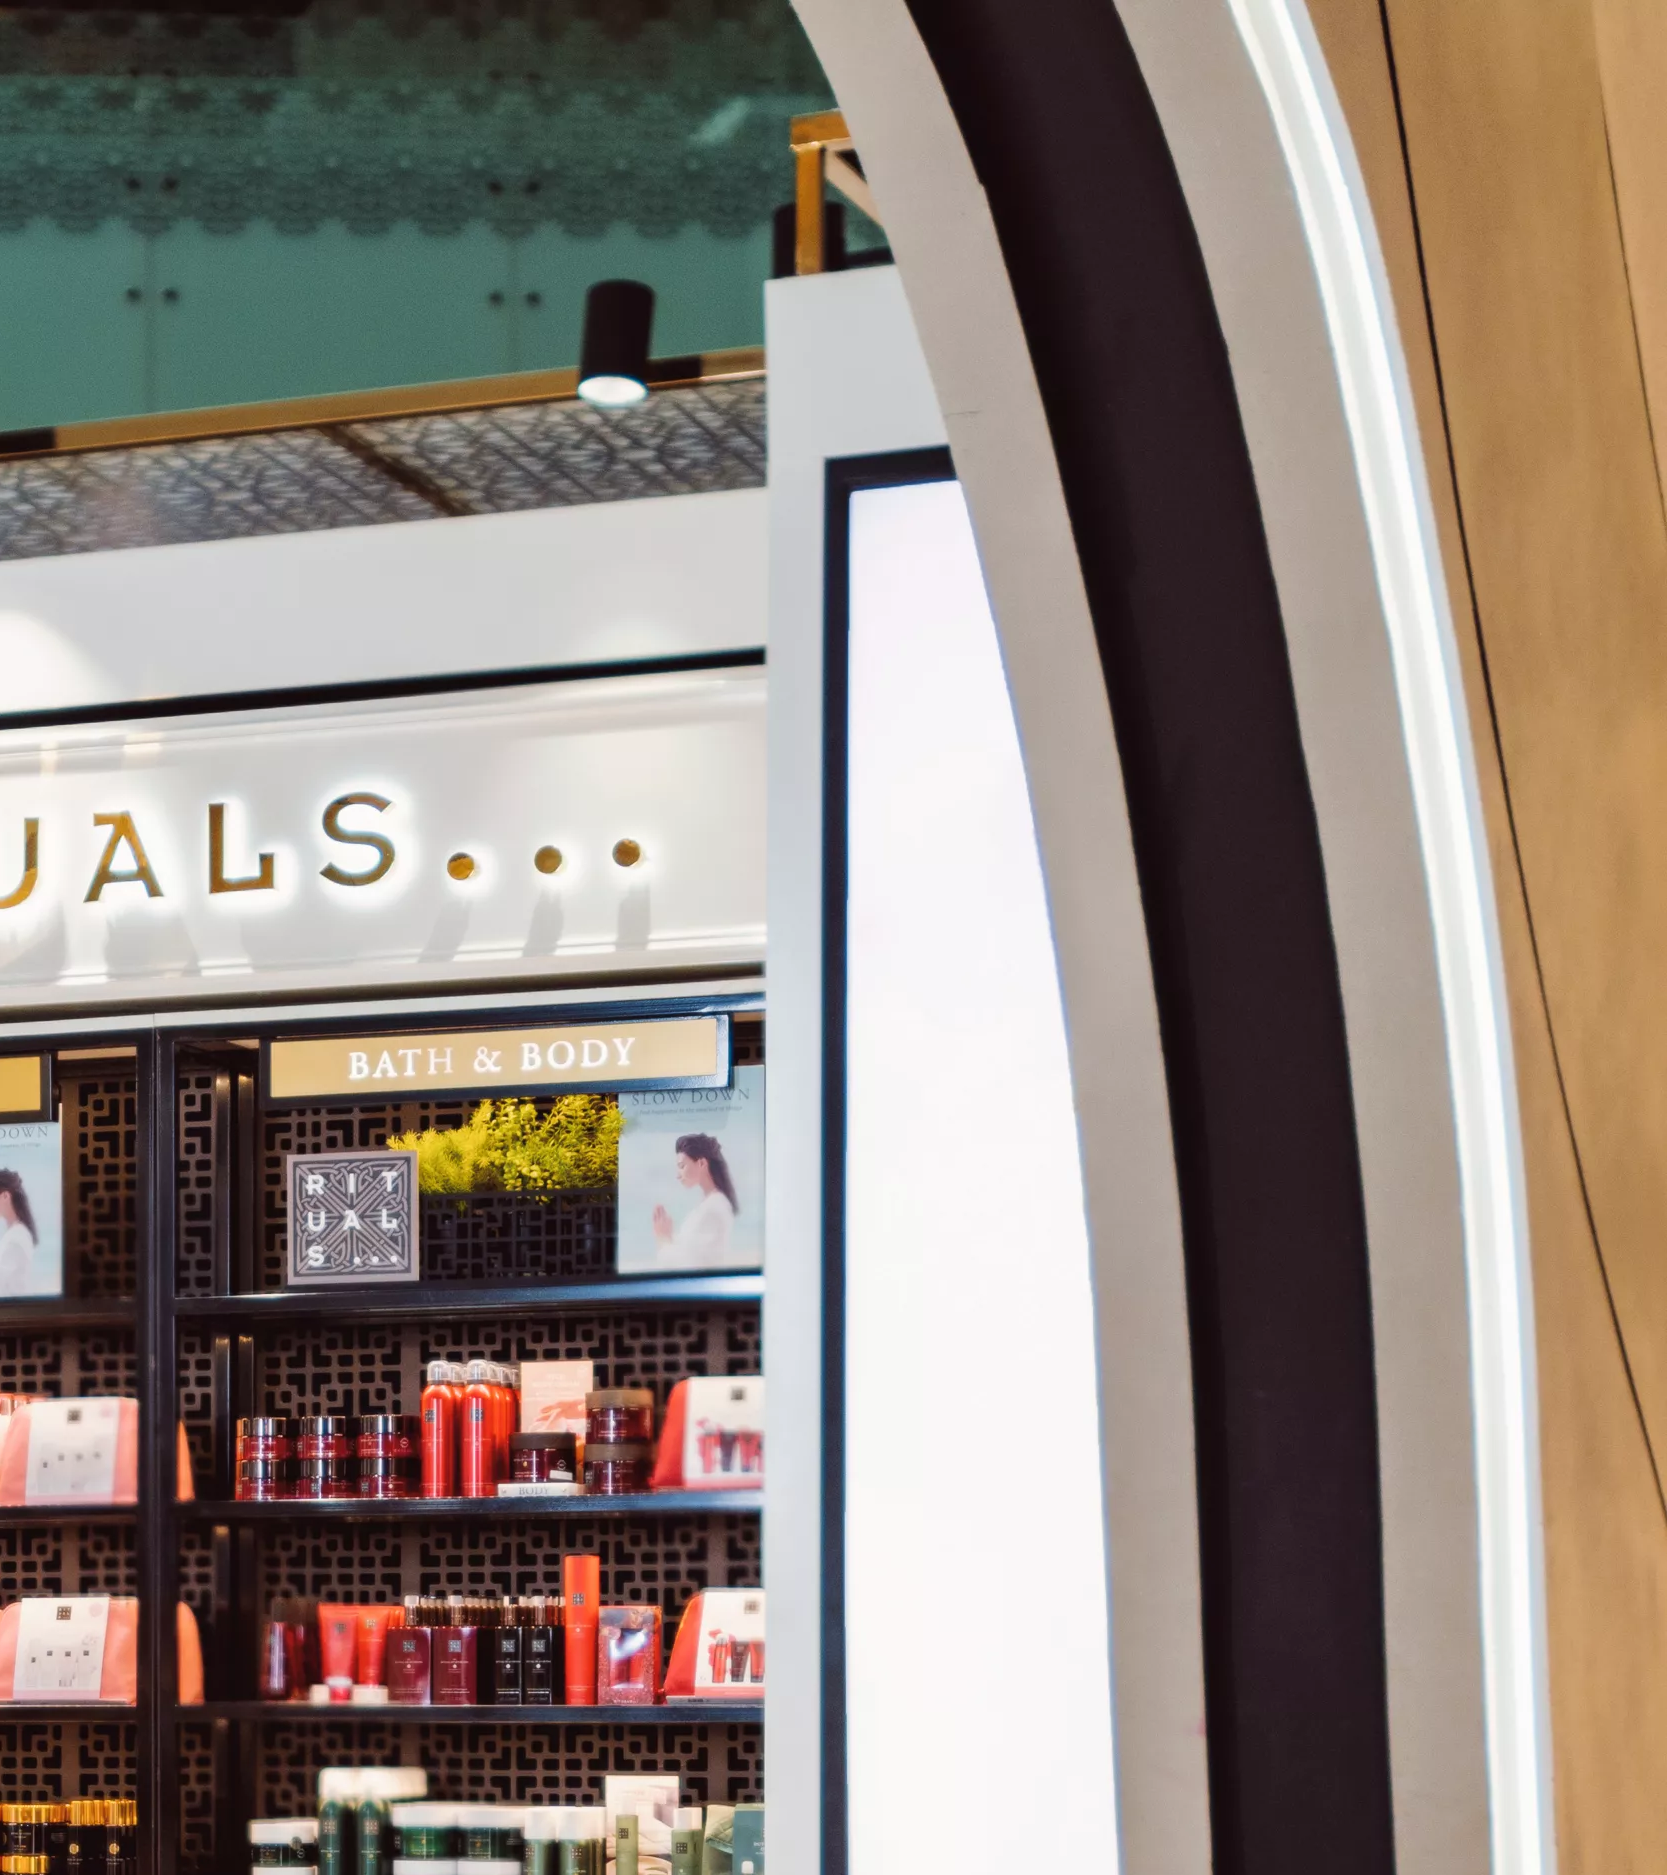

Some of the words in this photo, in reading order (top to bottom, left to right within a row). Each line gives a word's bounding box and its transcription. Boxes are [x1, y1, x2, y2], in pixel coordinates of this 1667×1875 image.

[349, 1046, 455, 1081] BATH
[473, 1045, 502, 1073] &
[521, 1036, 637, 1071] BODY
[632, 1090, 683, 1106] SLOW
[691, 1088, 750, 1103] DOWN
[519, 1486, 549, 1496] BODY
